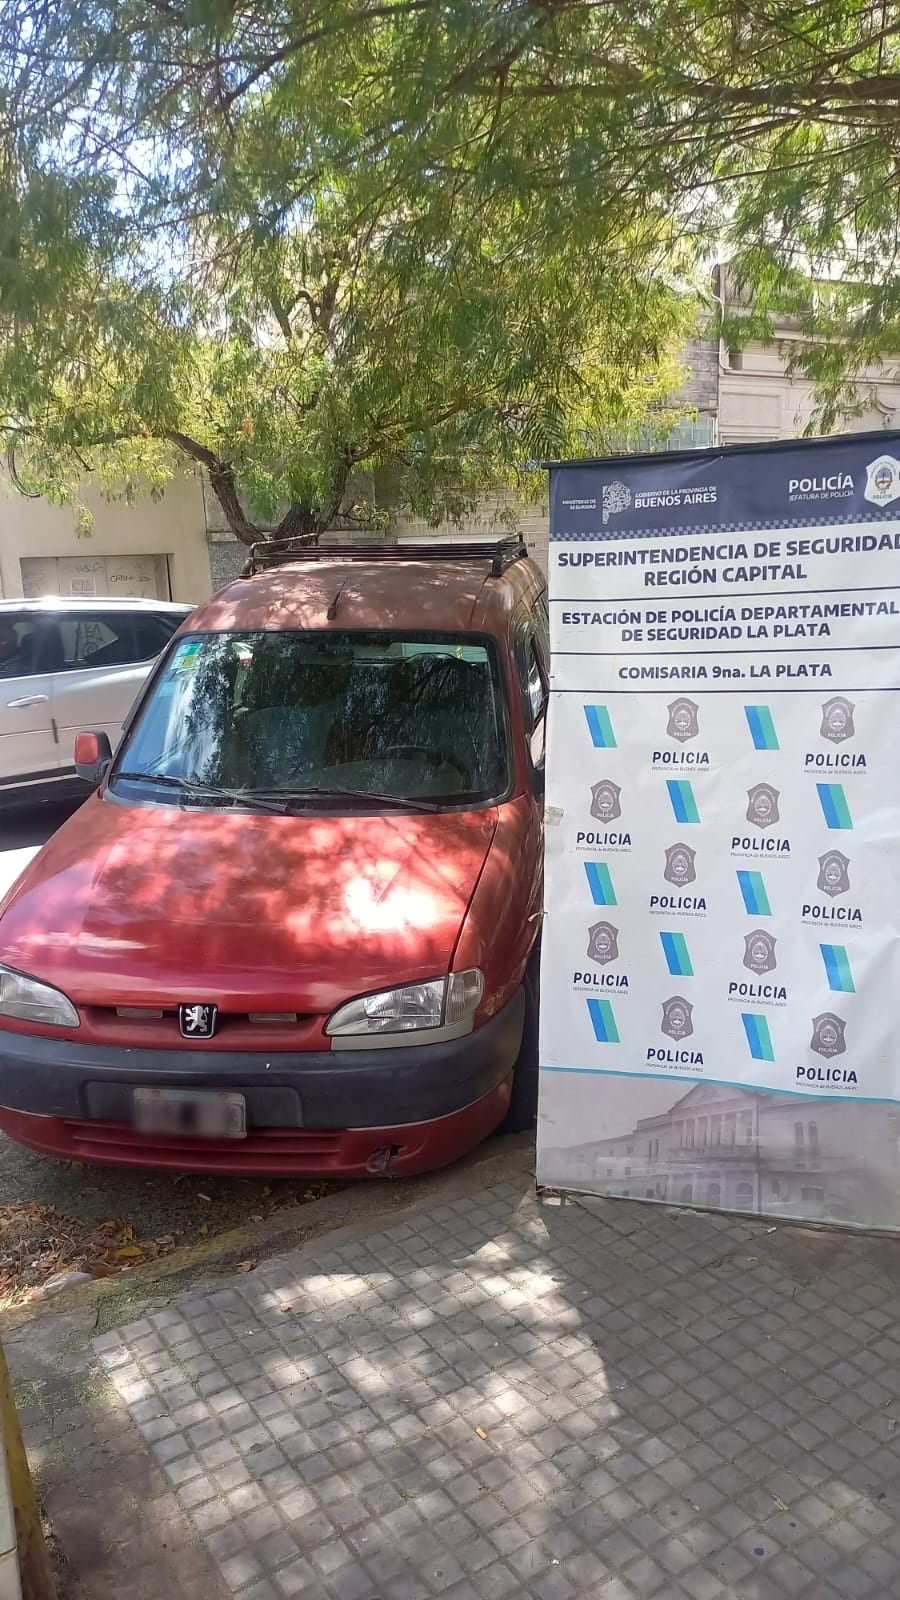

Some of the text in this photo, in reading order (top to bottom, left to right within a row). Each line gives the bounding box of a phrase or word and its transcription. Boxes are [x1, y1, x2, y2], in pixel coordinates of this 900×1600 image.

[789, 473, 853, 494] POLICÍA
[635, 492, 717, 508] BUENOS AIRES
[558, 544, 748, 569] SUPERINTENDENCIA
[754, 542, 780, 558] DE
[645, 564, 807, 586] REGIÓN CAPITAL
[562, 602, 899, 624] ESTACIÓN DE POLICÍA DEPARTAMENTAL
[622, 623, 830, 641] DE SEGURIDAD LA PLATA
[619, 664, 832, 679] COMISARIA 9na. LA PLATA
[653, 752, 709, 763] POLICIA
[805, 754, 866, 766] POLICIA
[577, 832, 631, 845] POLICIA
[732, 837, 790, 851] POLICIA
[650, 896, 706, 910] POLICIA
[802, 905, 862, 921] POLICIA
[574, 972, 628, 987] POLICIA
[729, 983, 786, 1001] POLICIA
[647, 1048, 703, 1065] POLICIA
[797, 1067, 857, 1083] POLICIA
